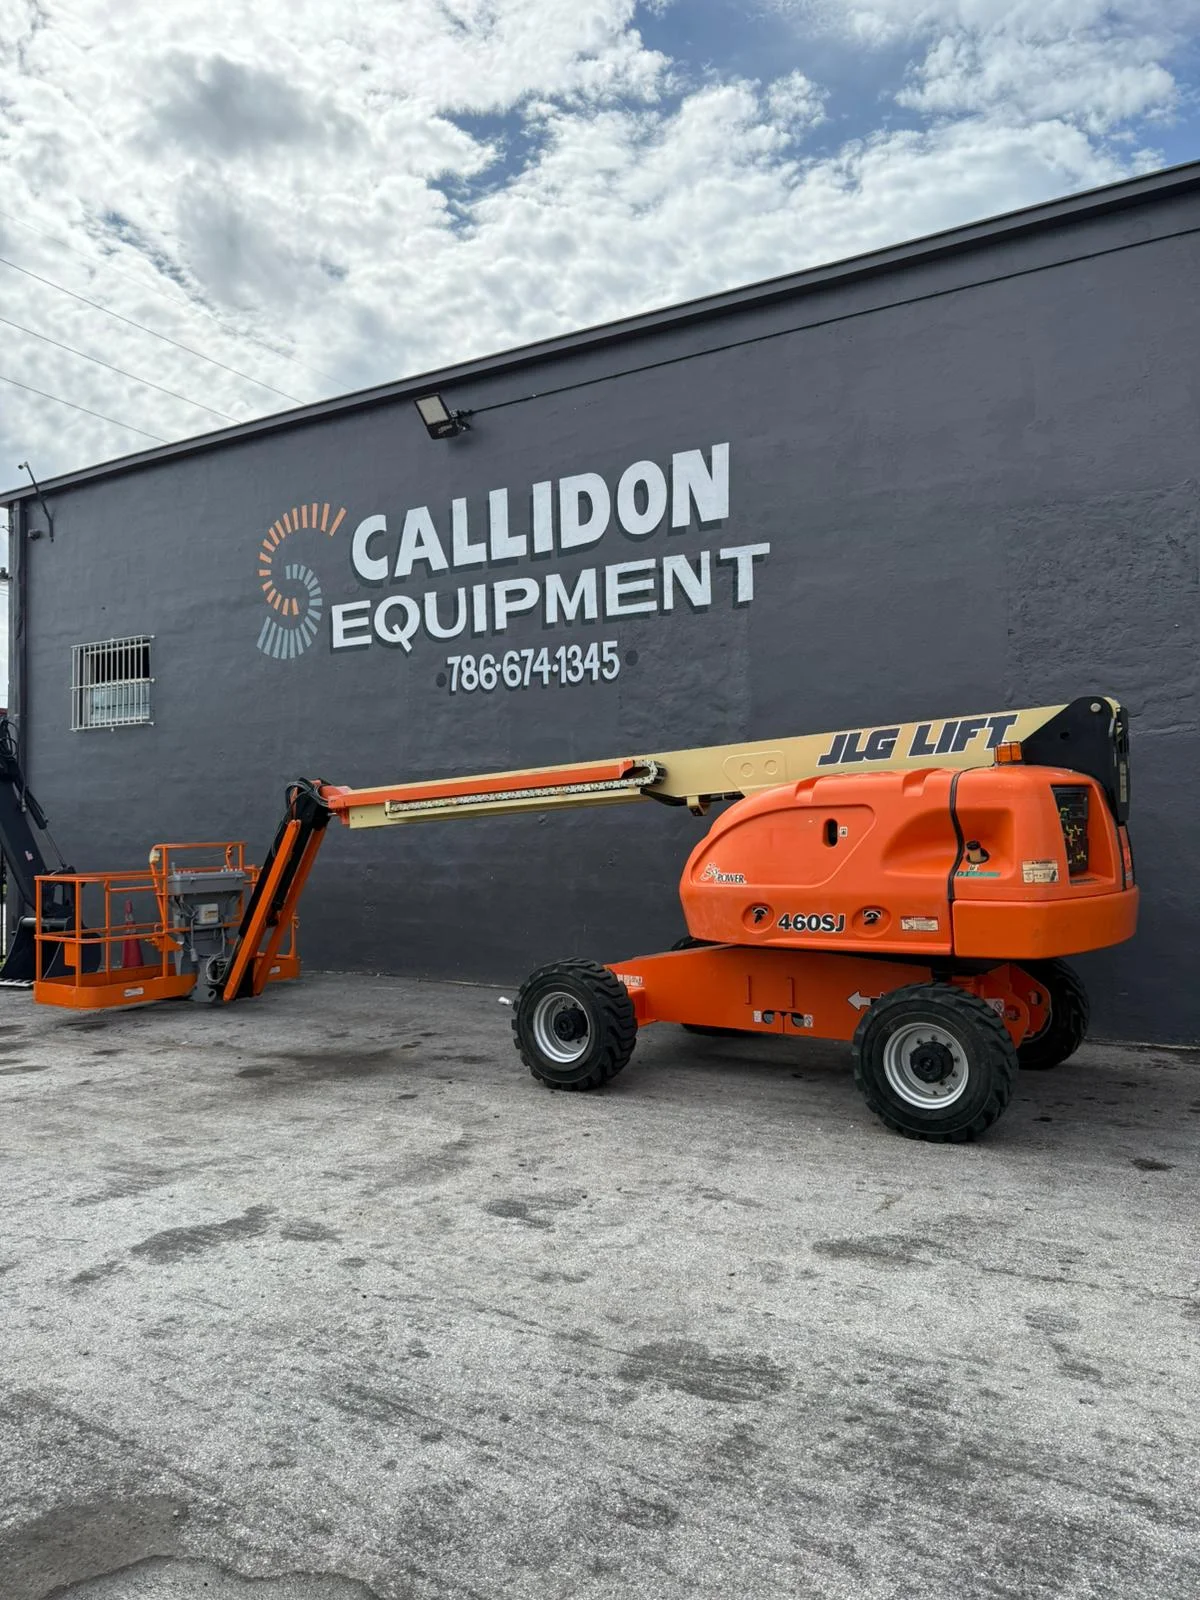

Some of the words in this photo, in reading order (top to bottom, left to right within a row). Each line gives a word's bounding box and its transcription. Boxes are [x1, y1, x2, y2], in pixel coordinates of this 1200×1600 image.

[352, 442, 730, 581] CALLIDON
[331, 542, 770, 653] EQUIPMENT
[817, 727, 900, 767] JLG
[907, 713, 1019, 757] LIFT
[777, 913, 846, 933] 460SJ
